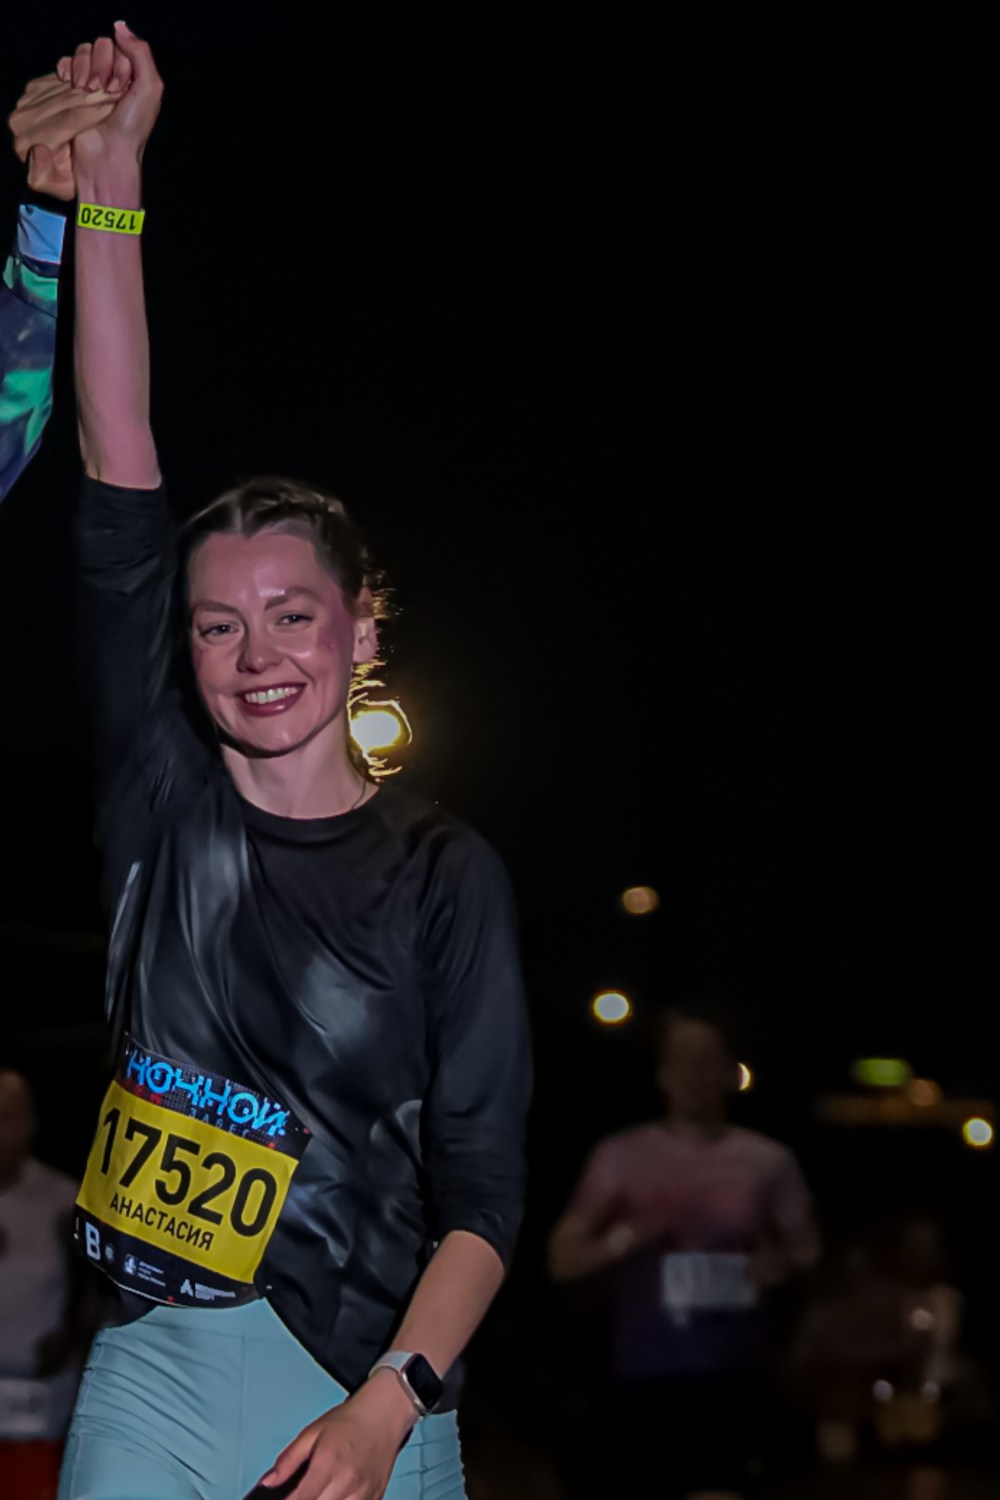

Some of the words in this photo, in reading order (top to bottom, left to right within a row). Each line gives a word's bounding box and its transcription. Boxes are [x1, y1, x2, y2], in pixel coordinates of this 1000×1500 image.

[81, 207, 136, 230] 17520
[126, 1049, 291, 1136] НОЧНОЙ
[101, 1107, 278, 1237] 17520
[110, 1193, 215, 1251] АНАСТАСИЯ
